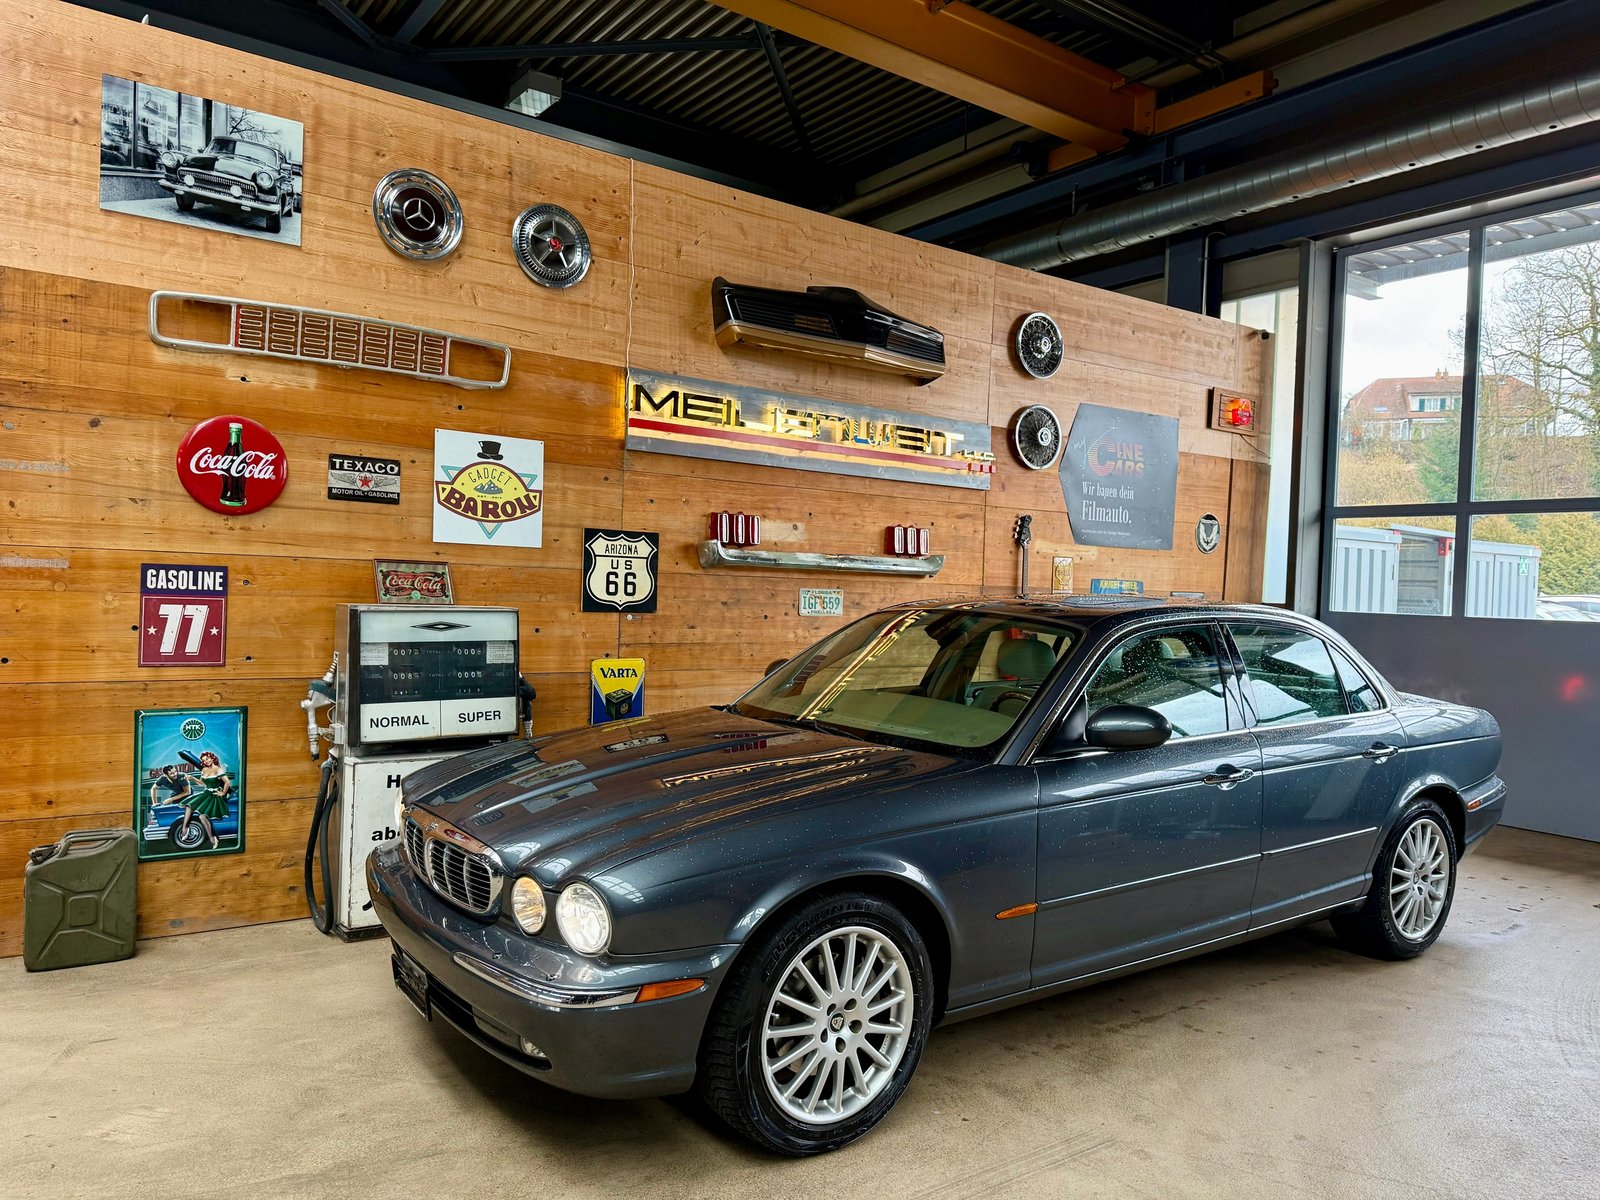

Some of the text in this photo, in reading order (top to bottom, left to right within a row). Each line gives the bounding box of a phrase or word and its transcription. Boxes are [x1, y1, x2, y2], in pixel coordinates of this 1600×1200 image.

[189, 446, 278, 480] Coca-Cola
[332, 458, 399, 474] TEXACO
[467, 467, 513, 486] GADGET
[332, 487, 354, 495] MOTOR
[368, 491, 399, 499] GASOLINE
[1082, 481, 1135, 500] Wir bauen dein
[442, 486, 538, 519] BARON
[1081, 500, 1132, 524] Filmauto.
[604, 543, 639, 556] ARIZONA
[610, 559, 633, 571] US
[146, 568, 224, 591] GASOLINE
[386, 574, 443, 591] Coca-Cola
[605, 571, 637, 597] 66
[158, 604, 210, 656] 77
[600, 667, 638, 679] VARTA
[370, 710, 501, 729] NORMAL SUPER
